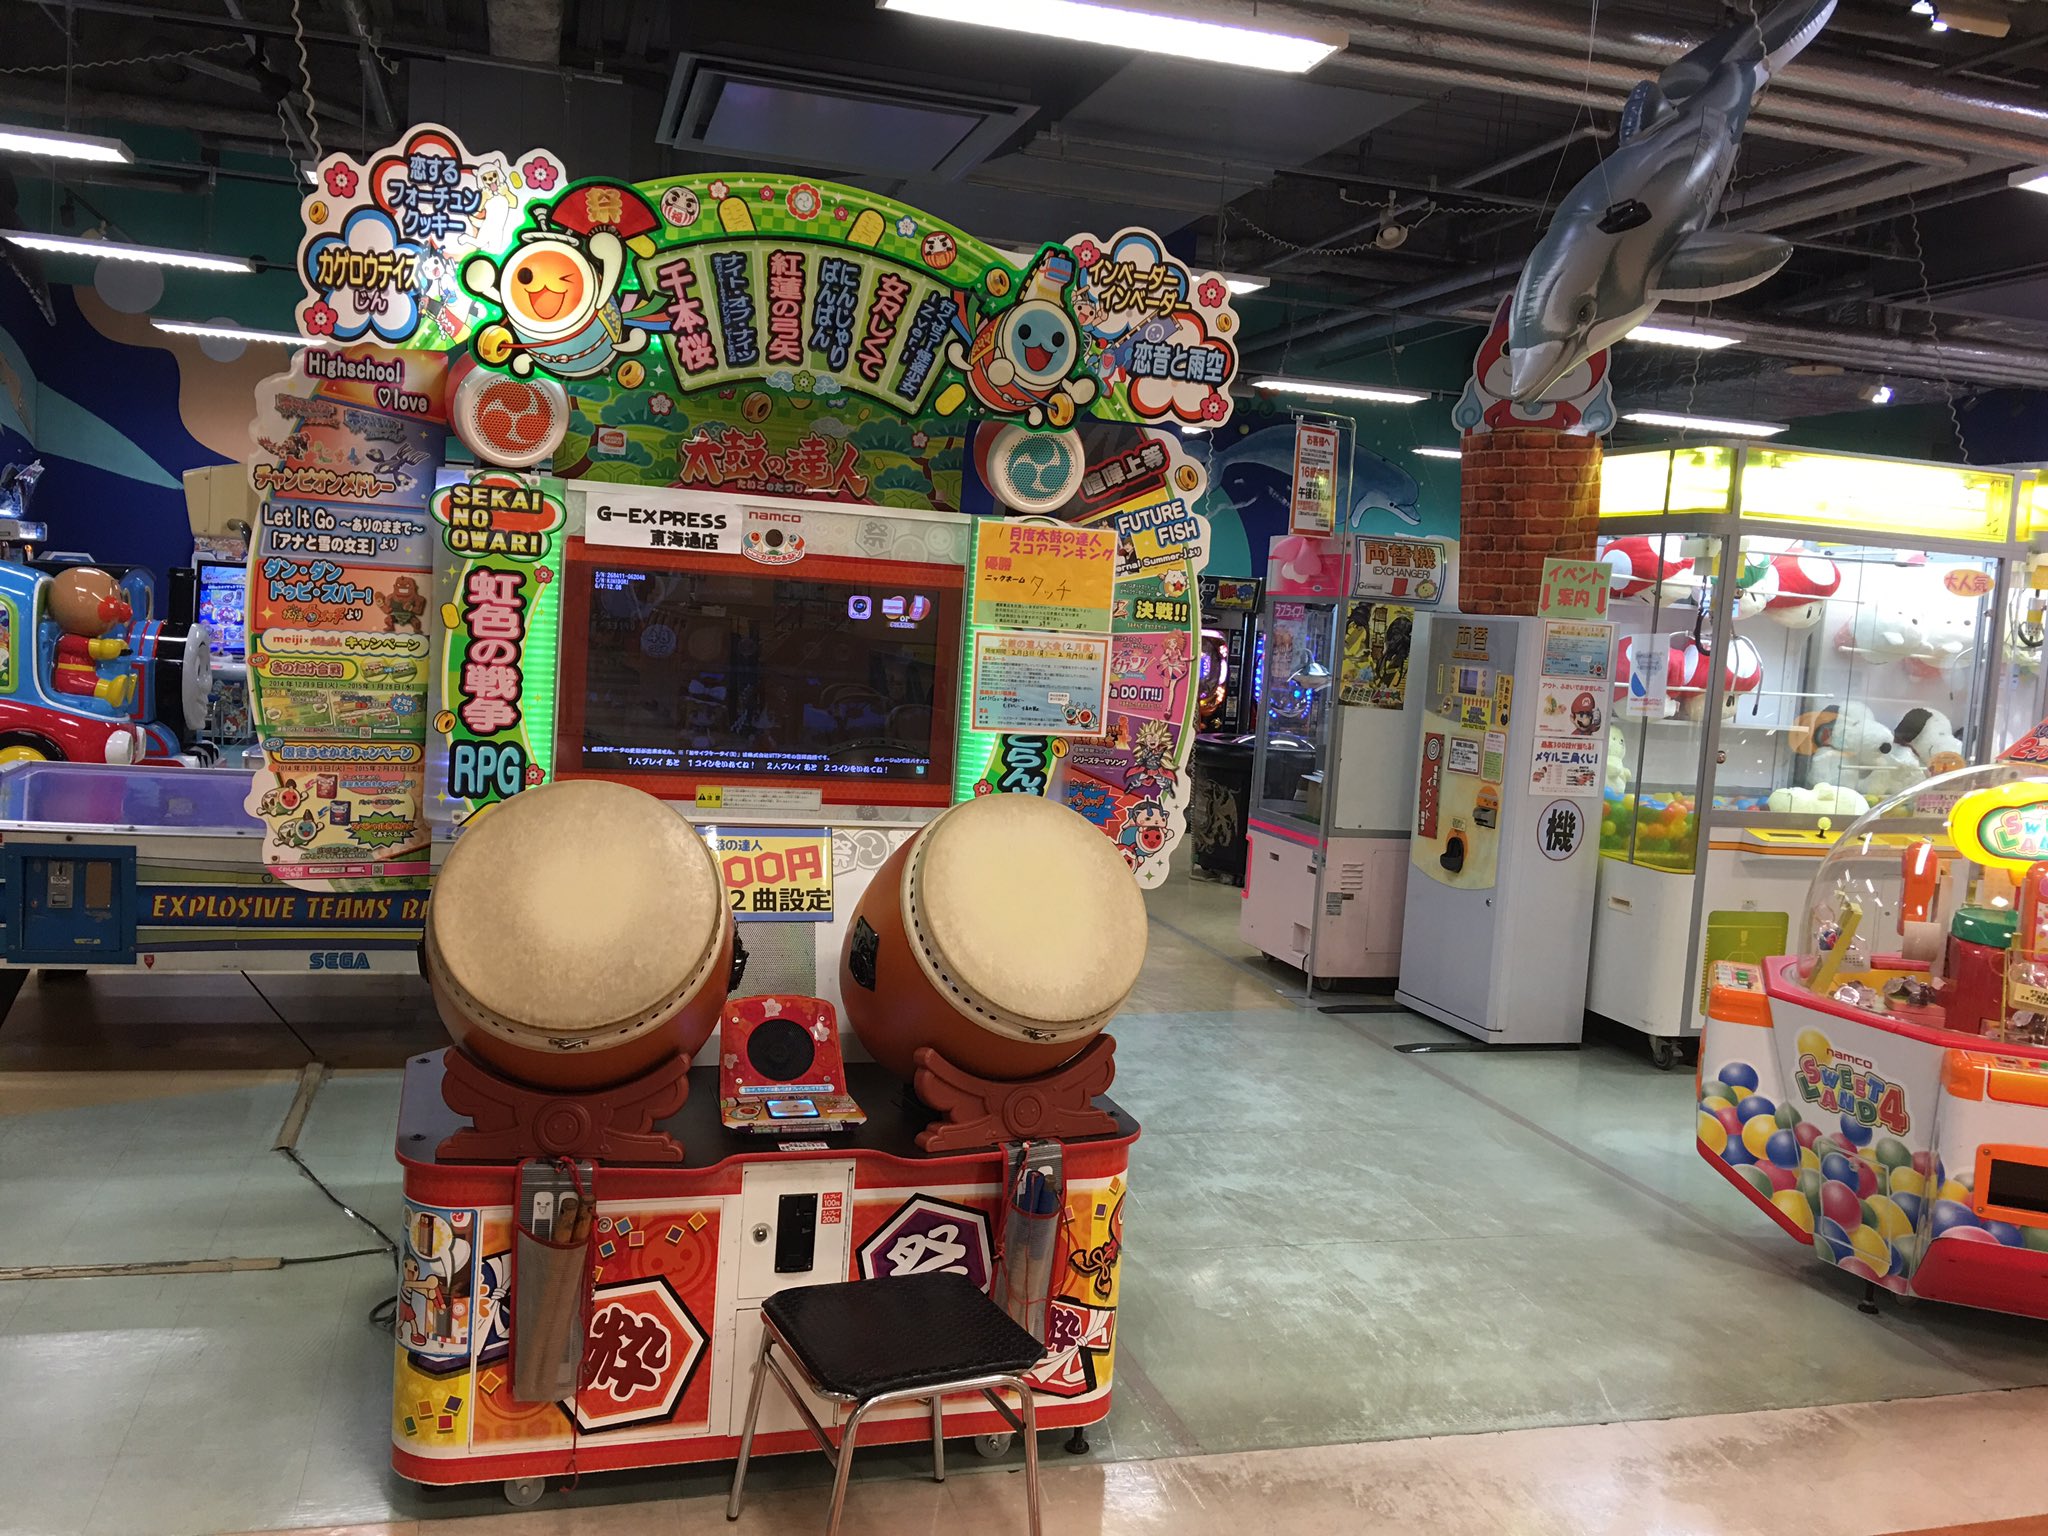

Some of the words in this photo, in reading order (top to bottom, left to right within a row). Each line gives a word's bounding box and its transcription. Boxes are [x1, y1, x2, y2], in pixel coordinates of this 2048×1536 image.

[409, 155, 460, 184] 恋する
[388, 181, 481, 214] フォーチュン
[404, 212, 466, 240] クッキー
[1089, 260, 1179, 290] インベーダー
[354, 289, 389, 313] じん
[768, 252, 803, 362] 紅蓮の弓矢
[1102, 287, 1191, 317] インベーダー
[659, 260, 717, 373] 千本桜
[858, 275, 910, 381] 女々しくて
[308, 351, 401, 383] Highschool
[1133, 340, 1226, 383] 恋音と雨空
[393, 388, 429, 413] love
[681, 427, 868, 498] 太鼓の達人
[1081, 444, 1164, 496] 喧嘩上等
[254, 466, 396, 497] チャンピオンメドレー
[452, 485, 543, 512] SEKAI
[264, 504, 292, 527] Let
[295, 508, 311, 528] It
[314, 511, 335, 530] Go
[452, 508, 490, 528] NO
[748, 510, 802, 524] namco
[1118, 501, 1185, 536] FUTURE
[452, 529, 543, 555] OWARI
[649, 528, 720, 551] 東海通店
[1157, 519, 1199, 547] FISH
[1009, 541, 1115, 562] スコアランキング
[1365, 541, 1437, 570] 両替機
[1372, 565, 1431, 579] (EXCHANGER)
[1548, 564, 1605, 585] イベント
[1945, 574, 1989, 592] 大人気
[1557, 588, 1592, 608] 案内
[273, 634, 303, 646] meiji
[344, 635, 421, 651] キャンペーン
[463, 570, 523, 733] 虹色の戦争
[1456, 626, 1489, 651] 両替
[1121, 686, 1137, 699] DO
[453, 744, 524, 796] RPG
[1073, 756, 1127, 766] シリーズテーマソング
[1546, 807, 1578, 853] 機
[152, 895, 297, 920] EXPLOSIVE
[306, 897, 392, 920] TEAMS
[309, 952, 371, 970] SEGA
[1826, 1047, 1873, 1070] namco
[1803, 1059, 1885, 1104] SWEET
[1799, 1074, 1877, 1124] LAND
[1879, 1086, 1908, 1135] 4
